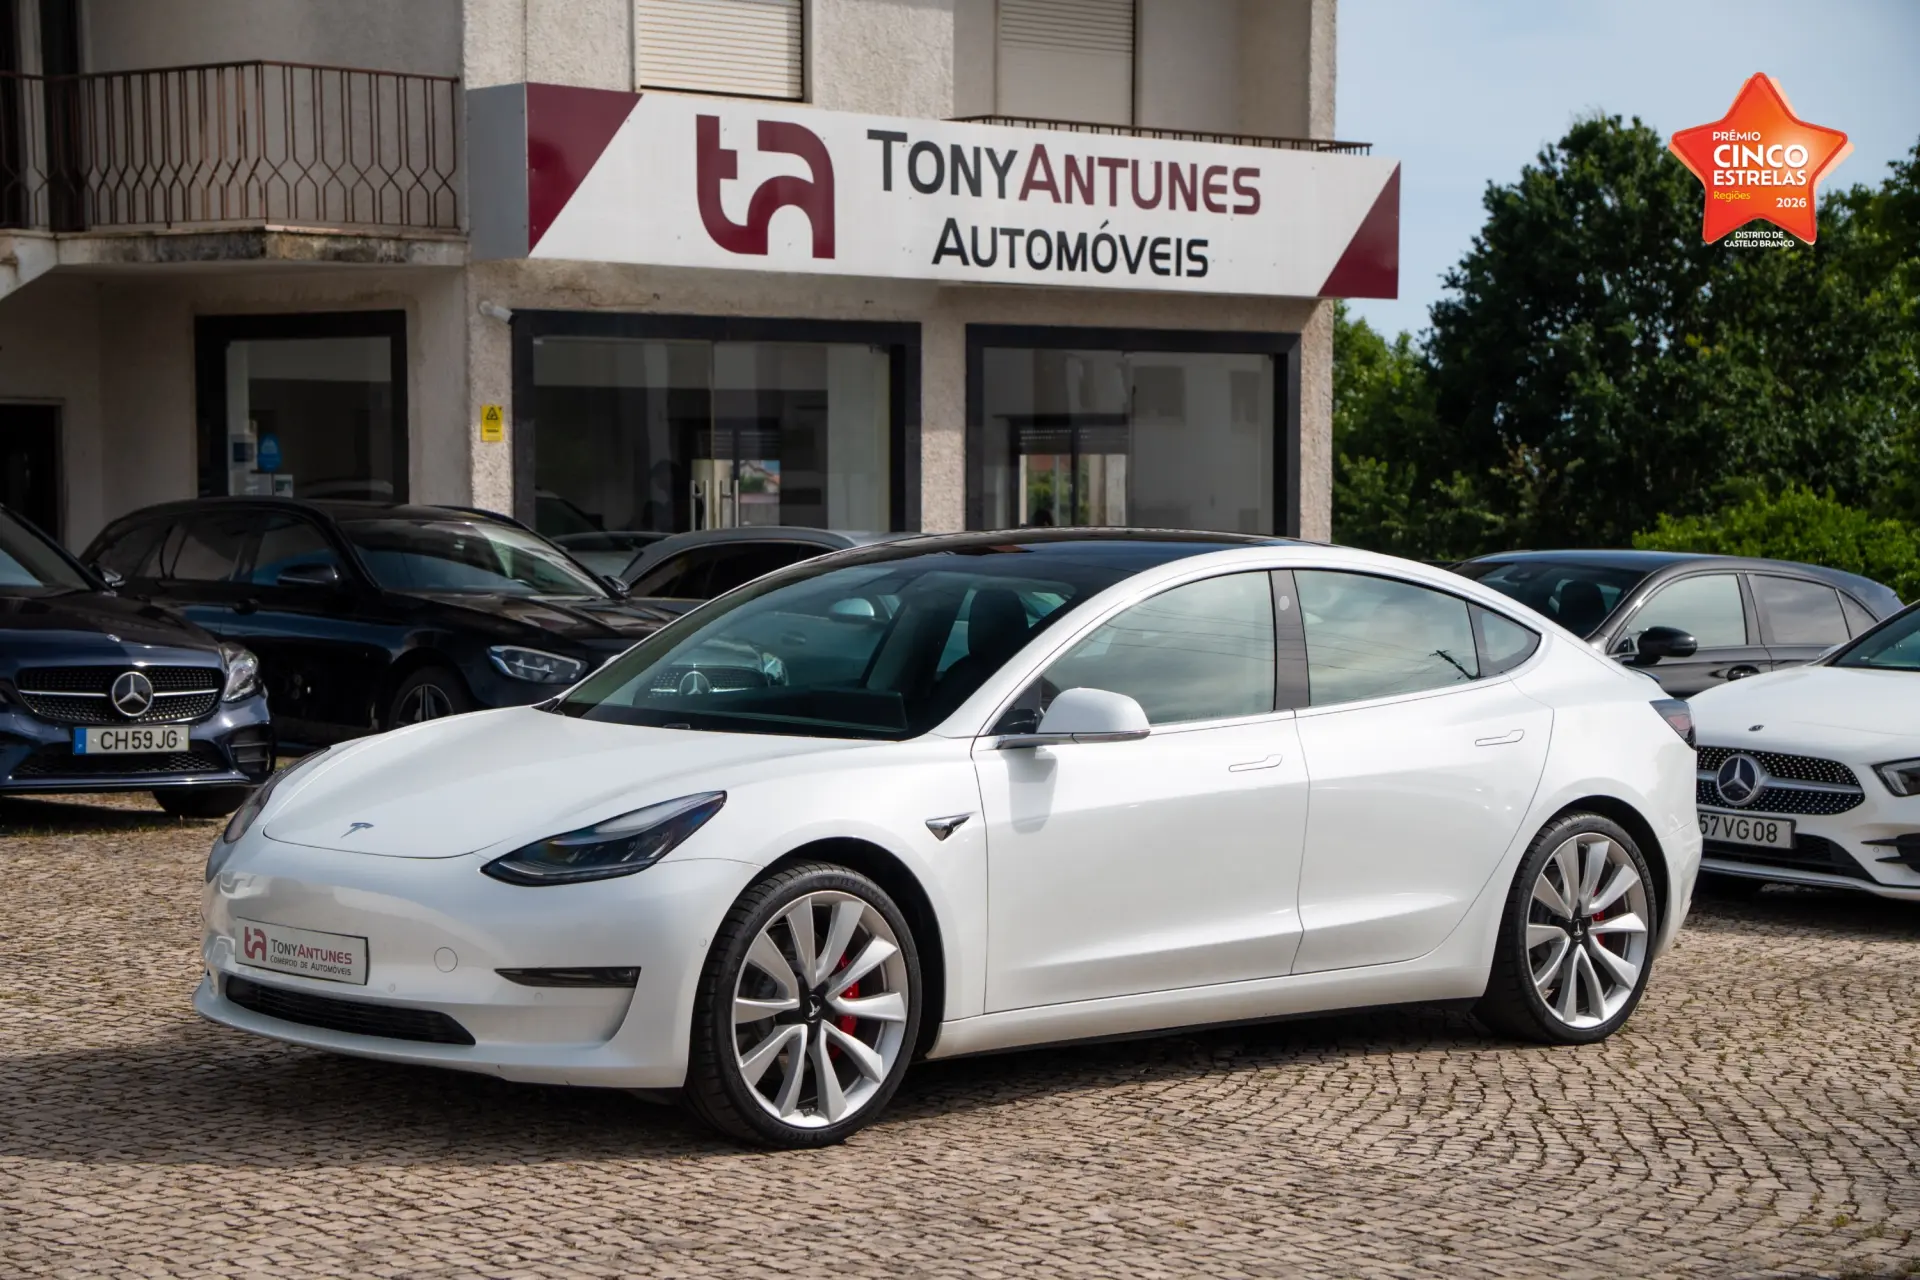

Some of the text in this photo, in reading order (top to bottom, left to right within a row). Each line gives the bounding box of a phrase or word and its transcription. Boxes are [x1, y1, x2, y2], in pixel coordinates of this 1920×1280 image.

[931, 217, 1209, 278] AUTOMÓVEIS
[300, 961, 308, 969] DE
[311, 962, 351, 976] AUTOMÓVEIS
